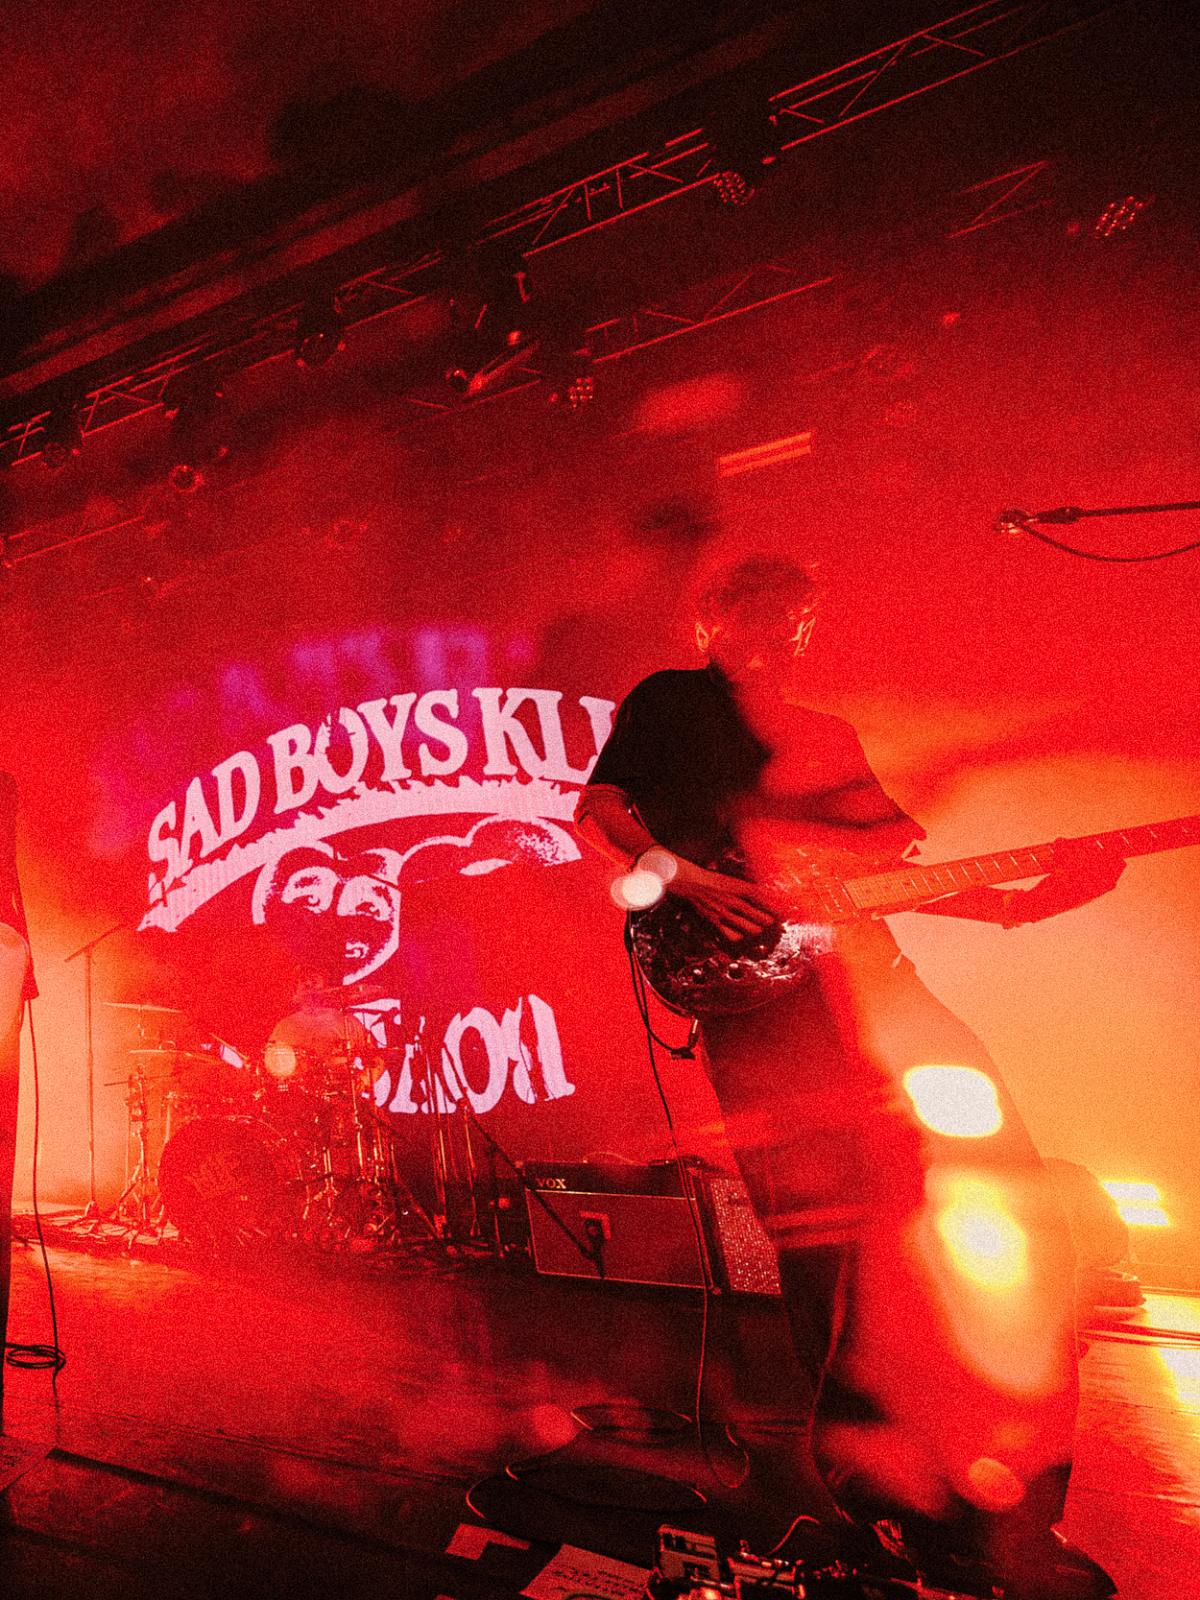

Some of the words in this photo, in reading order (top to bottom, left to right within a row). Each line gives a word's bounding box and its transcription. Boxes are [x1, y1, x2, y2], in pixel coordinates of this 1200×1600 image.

[148, 750, 261, 904] SAD
[266, 689, 469, 815] BOYS
[535, 1177, 567, 1189] VOX
